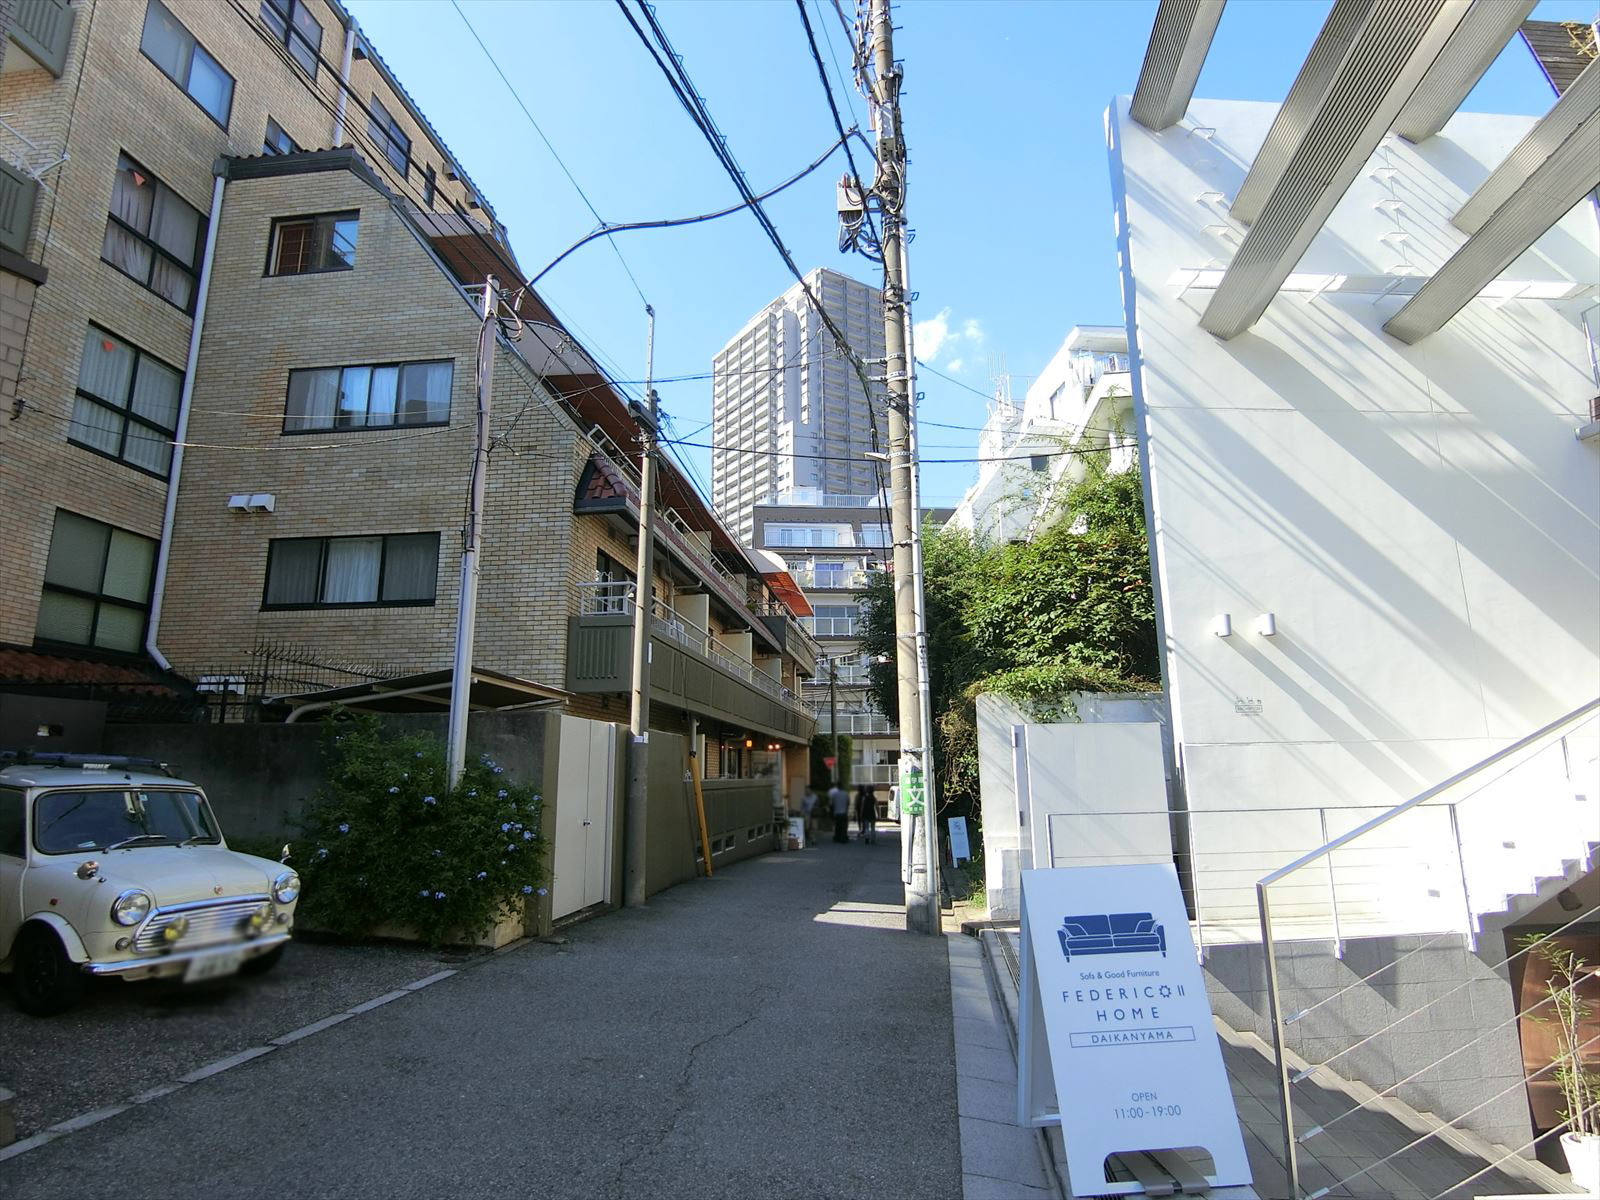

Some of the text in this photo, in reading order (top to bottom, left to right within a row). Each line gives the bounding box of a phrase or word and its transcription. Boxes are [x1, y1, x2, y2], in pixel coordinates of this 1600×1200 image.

[1097, 971, 1103, 979] &
[1105, 970, 1125, 979] Good
[1127, 969, 1160, 978] Furniture
[1097, 1007, 1160, 1022] HOME
[1091, 1031, 1174, 1044] DAIKANYAMA
[1131, 1092, 1157, 1102] OPEN
[1114, 1104, 1182, 1119] 11:00-19:00
